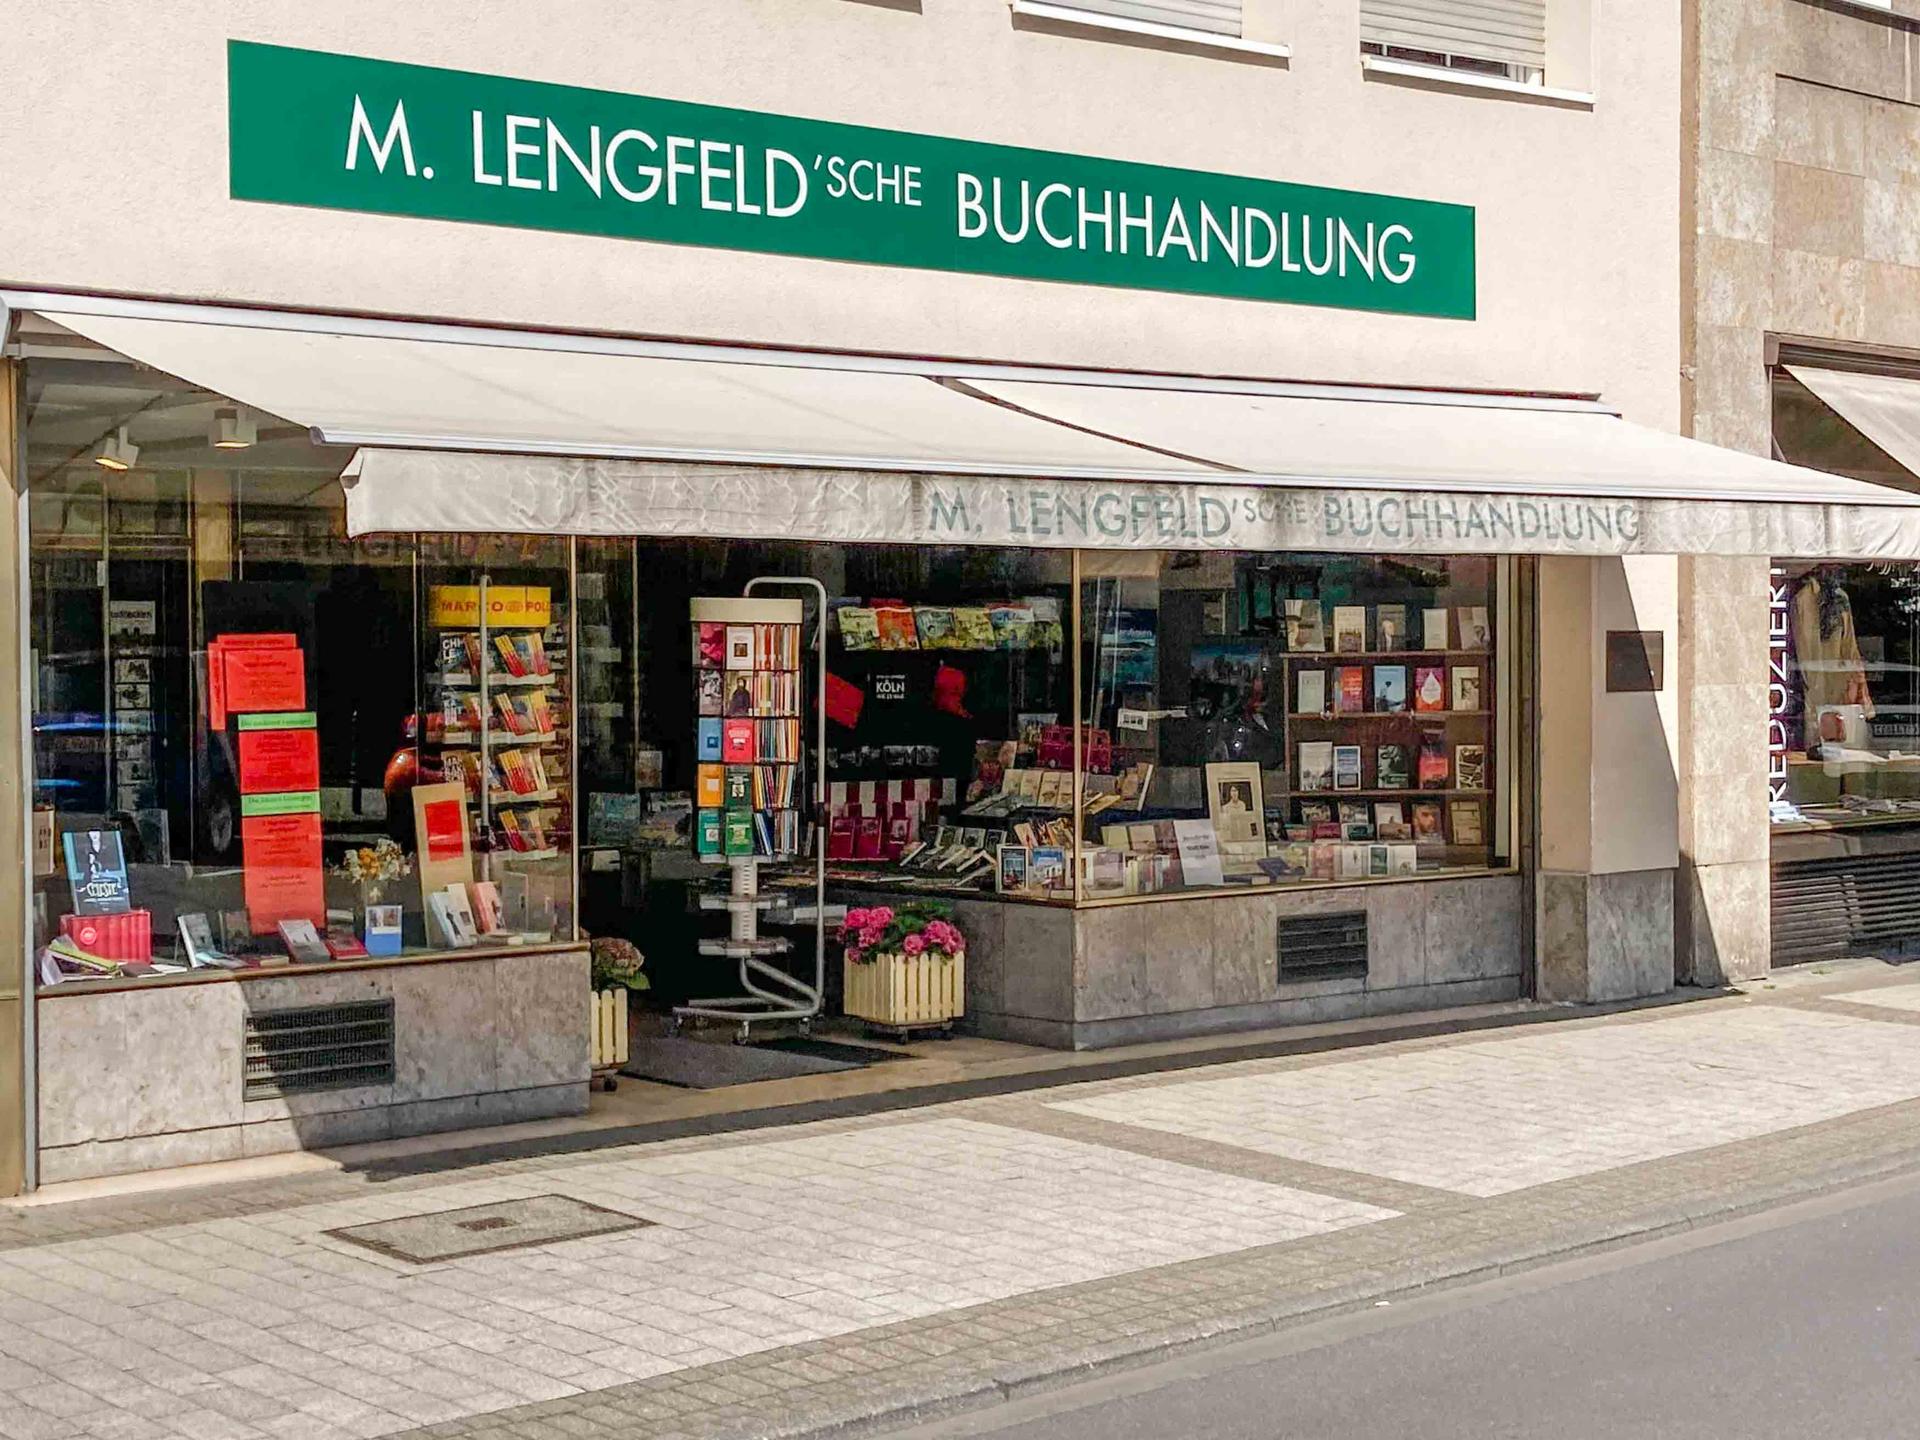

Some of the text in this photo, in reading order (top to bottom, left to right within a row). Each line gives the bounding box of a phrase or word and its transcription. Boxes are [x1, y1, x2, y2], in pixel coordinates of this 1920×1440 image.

[345, 94, 434, 180] M.
[957, 172, 1416, 284] BUCHHANDLUNG
[929, 487, 982, 533] M.
[1323, 496, 1639, 541] BUCHHANDLUNG
[442, 600, 503, 612] MARO
[875, 679, 905, 693] KÖLN
